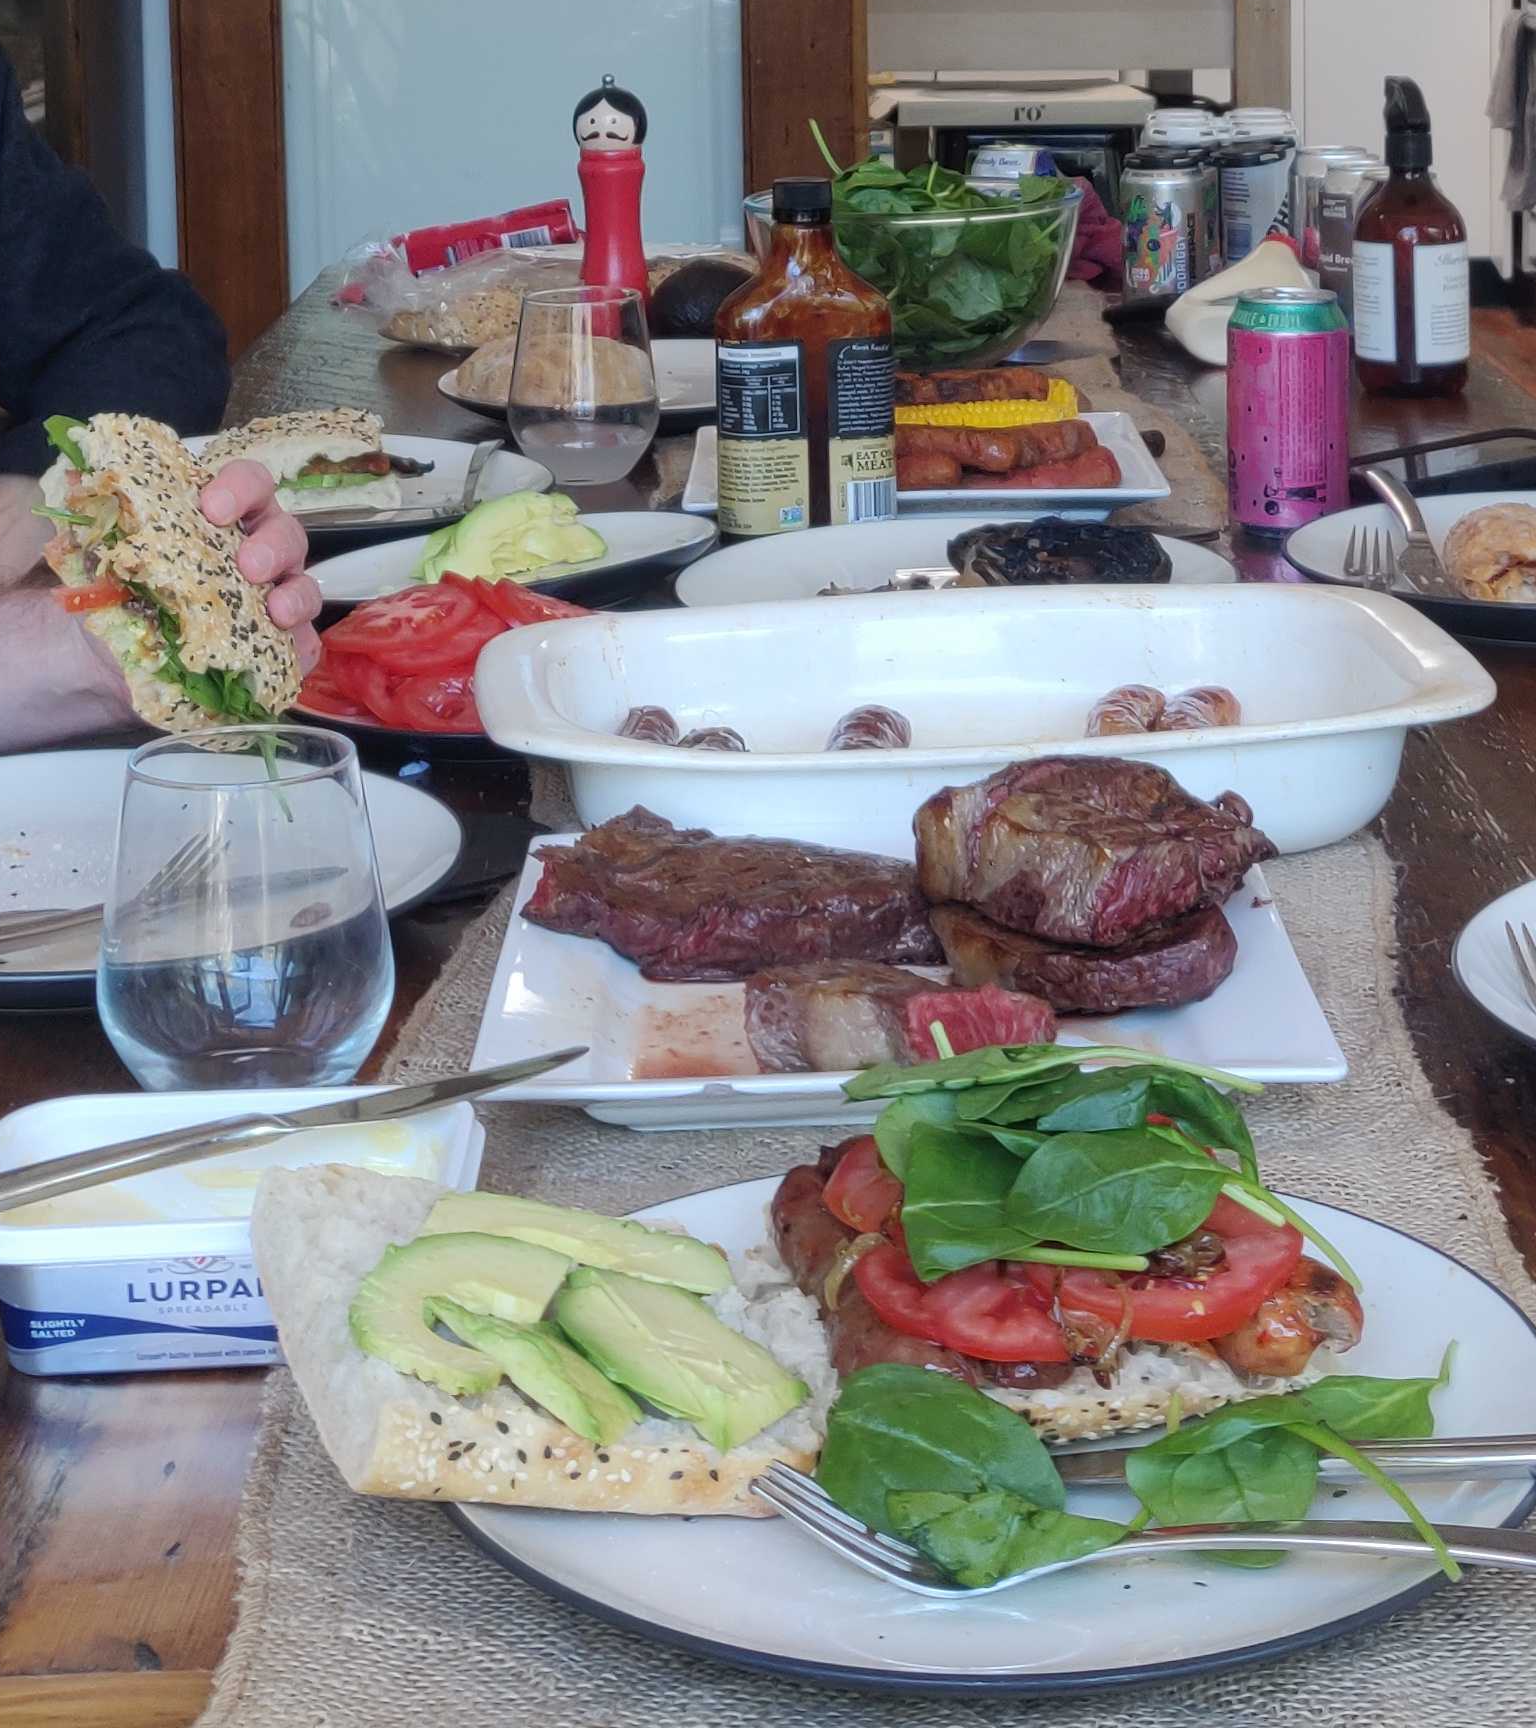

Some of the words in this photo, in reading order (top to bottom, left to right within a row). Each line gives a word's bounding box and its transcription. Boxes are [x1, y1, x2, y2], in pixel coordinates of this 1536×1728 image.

[857, 451, 879, 460] EAT
[158, 1303, 249, 1314] SPREADABLE
[30, 1318, 86, 1329] SLIGHTLY
[31, 1329, 76, 1339] SALTED
